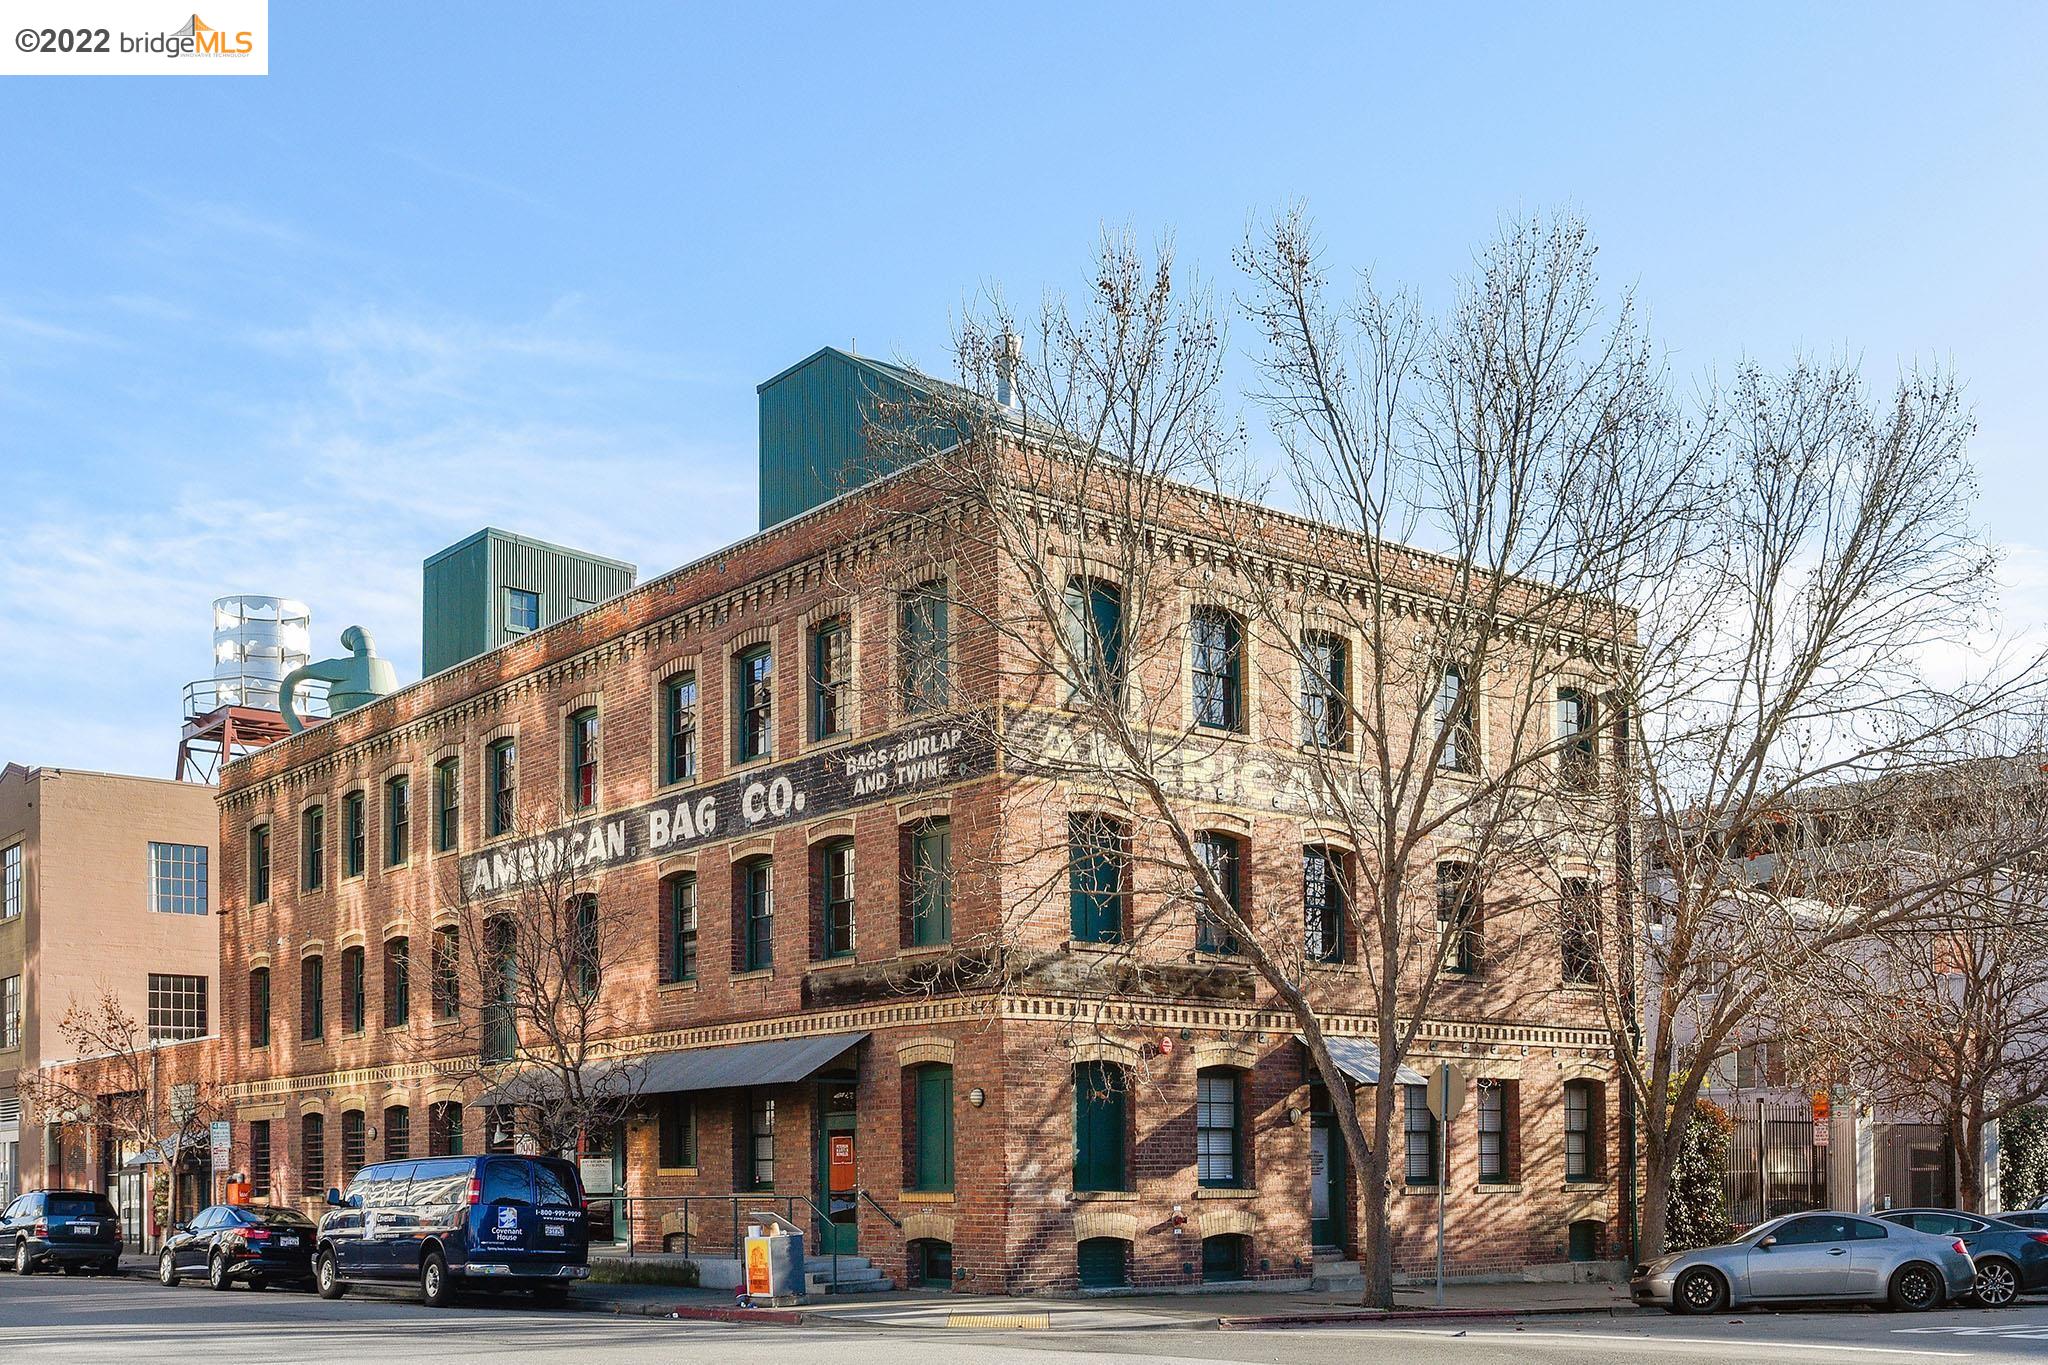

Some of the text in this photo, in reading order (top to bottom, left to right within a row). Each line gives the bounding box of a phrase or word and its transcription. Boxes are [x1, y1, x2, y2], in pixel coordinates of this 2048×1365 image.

[897, 729, 961, 762] BURLAP
[853, 756, 949, 797] AND TWINE
[471, 776, 805, 894] AMERICAN BAG CO.
[491, 1227, 522, 1235] Covenant
